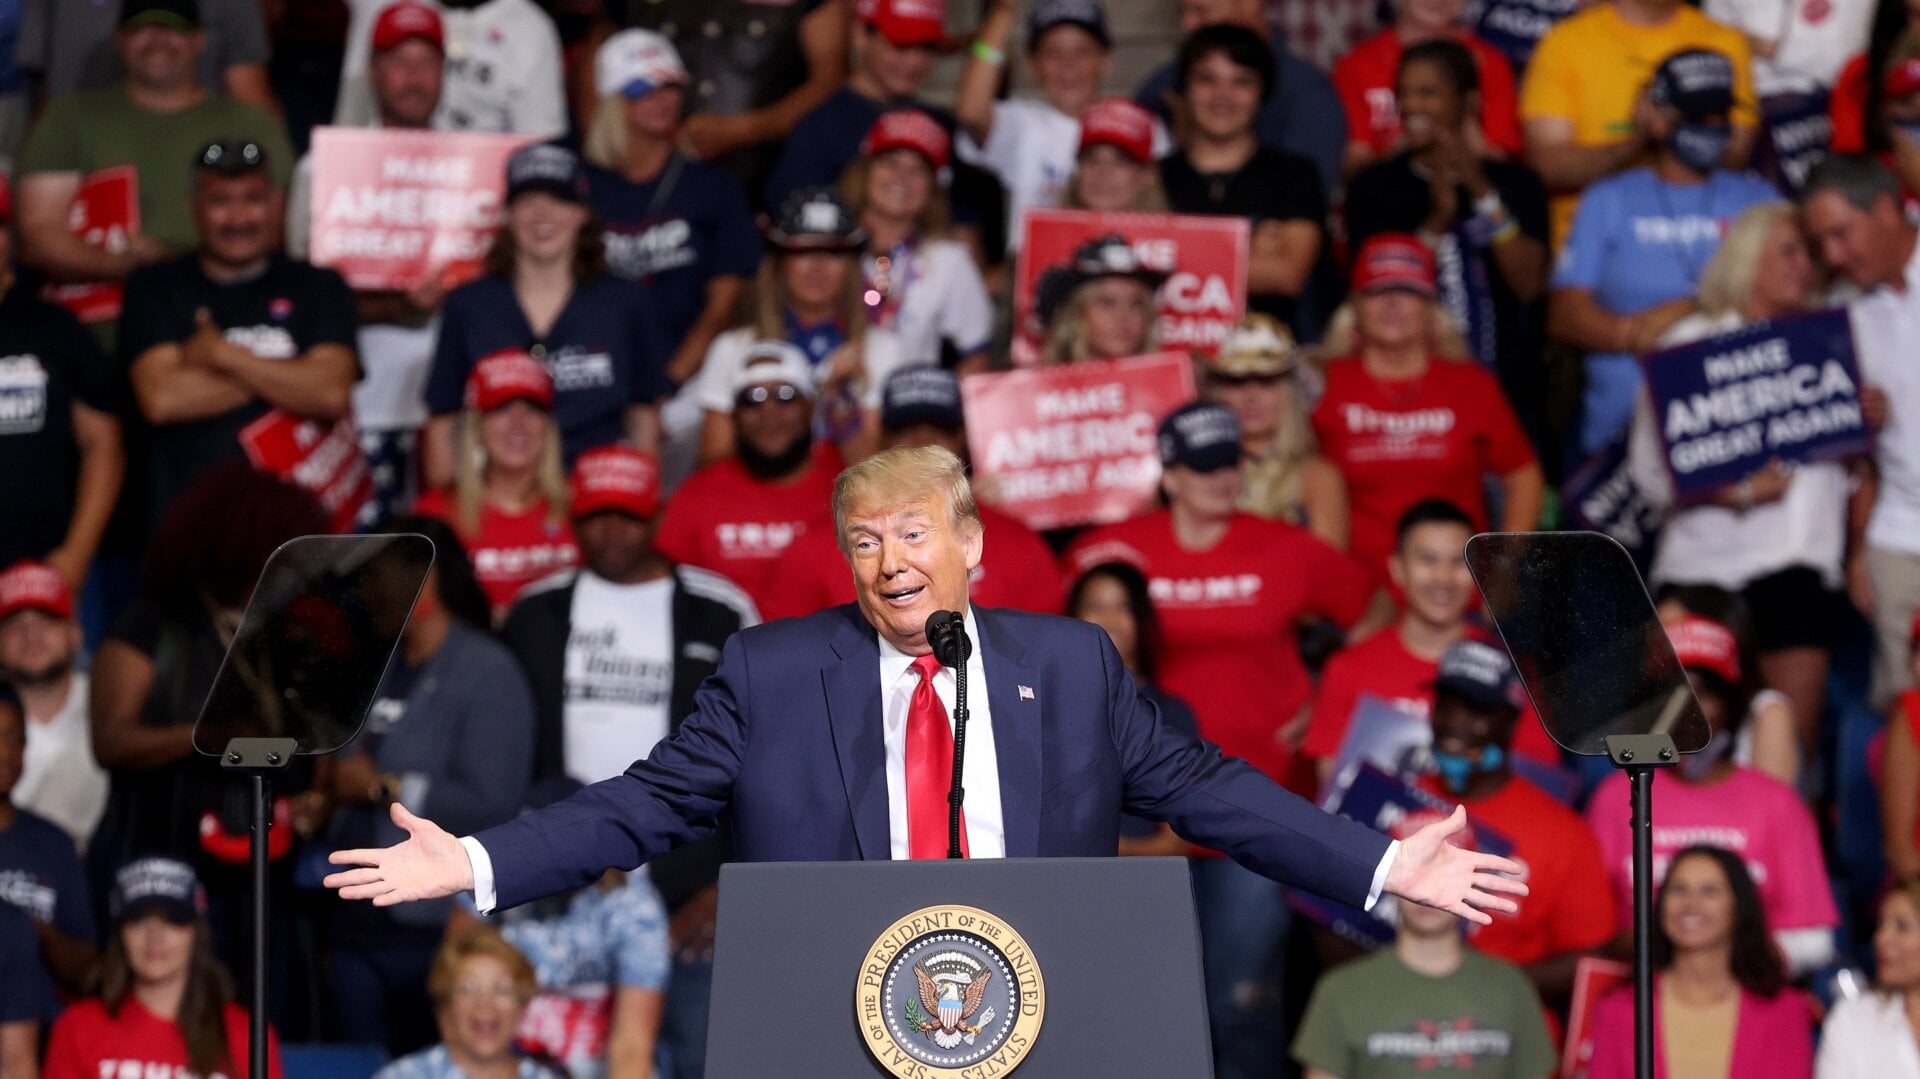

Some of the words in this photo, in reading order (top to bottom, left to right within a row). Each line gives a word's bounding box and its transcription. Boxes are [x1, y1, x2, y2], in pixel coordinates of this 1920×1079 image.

[383, 156, 472, 184] MAKE
[323, 230, 423, 258] GREAT
[1134, 240, 1178, 270] KE
[1159, 315, 1230, 344] GAIN
[1704, 338, 1791, 386] MAKE
[1034, 384, 1125, 417] MAKE
[1665, 360, 1856, 441] AMERICA
[1341, 403, 1455, 435] Trump
[986, 413, 1157, 467] AMERIC
[1671, 422, 1763, 473] GREAT
[1766, 401, 1864, 447] AGAIN
[717, 522, 794, 548] TRU
[476, 544, 578, 573] RUMP
[1148, 574, 1262, 600] RUMP
[958, 915, 977, 927] OF
[979, 920, 1002, 940] THE
[863, 912, 953, 989] PRESIDENT
[1004, 938, 1039, 1017] UNITED
[865, 995, 878, 1020] THE
[870, 1024, 884, 1041] OF
[882, 1040, 928, 1079] SEAL
[961, 1032, 1027, 1079] STATES
